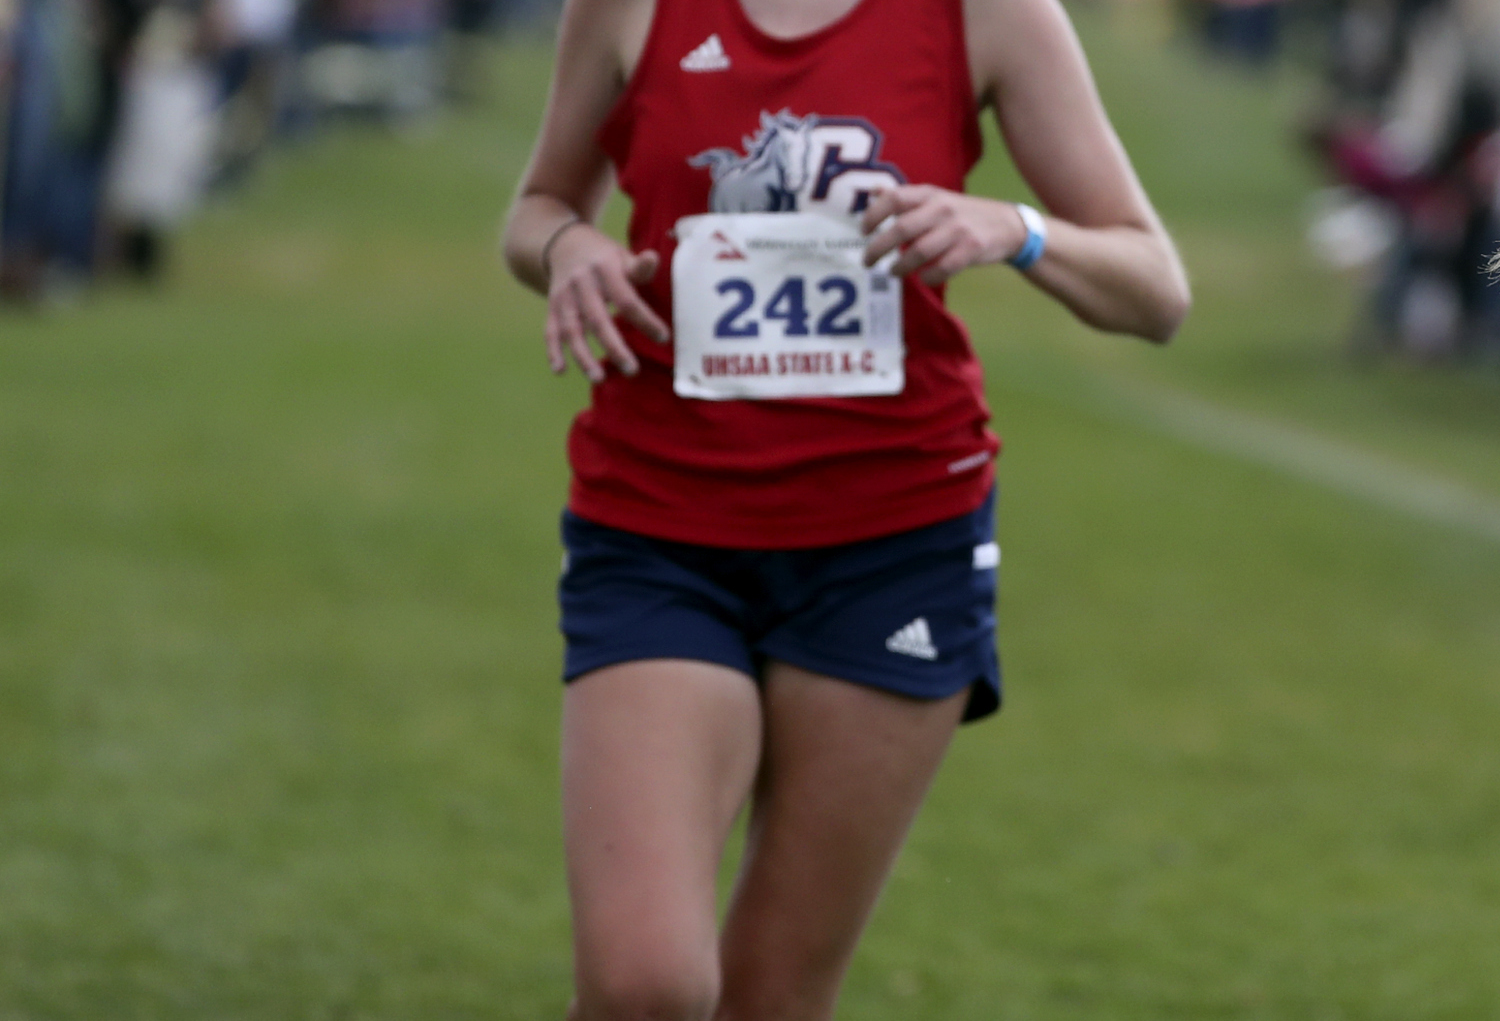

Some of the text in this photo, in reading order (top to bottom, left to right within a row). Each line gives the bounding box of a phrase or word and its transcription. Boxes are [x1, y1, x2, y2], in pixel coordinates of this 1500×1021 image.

[713, 276, 862, 338] 242
[702, 354, 771, 377] UHSAA
[777, 351, 833, 374] STATE
